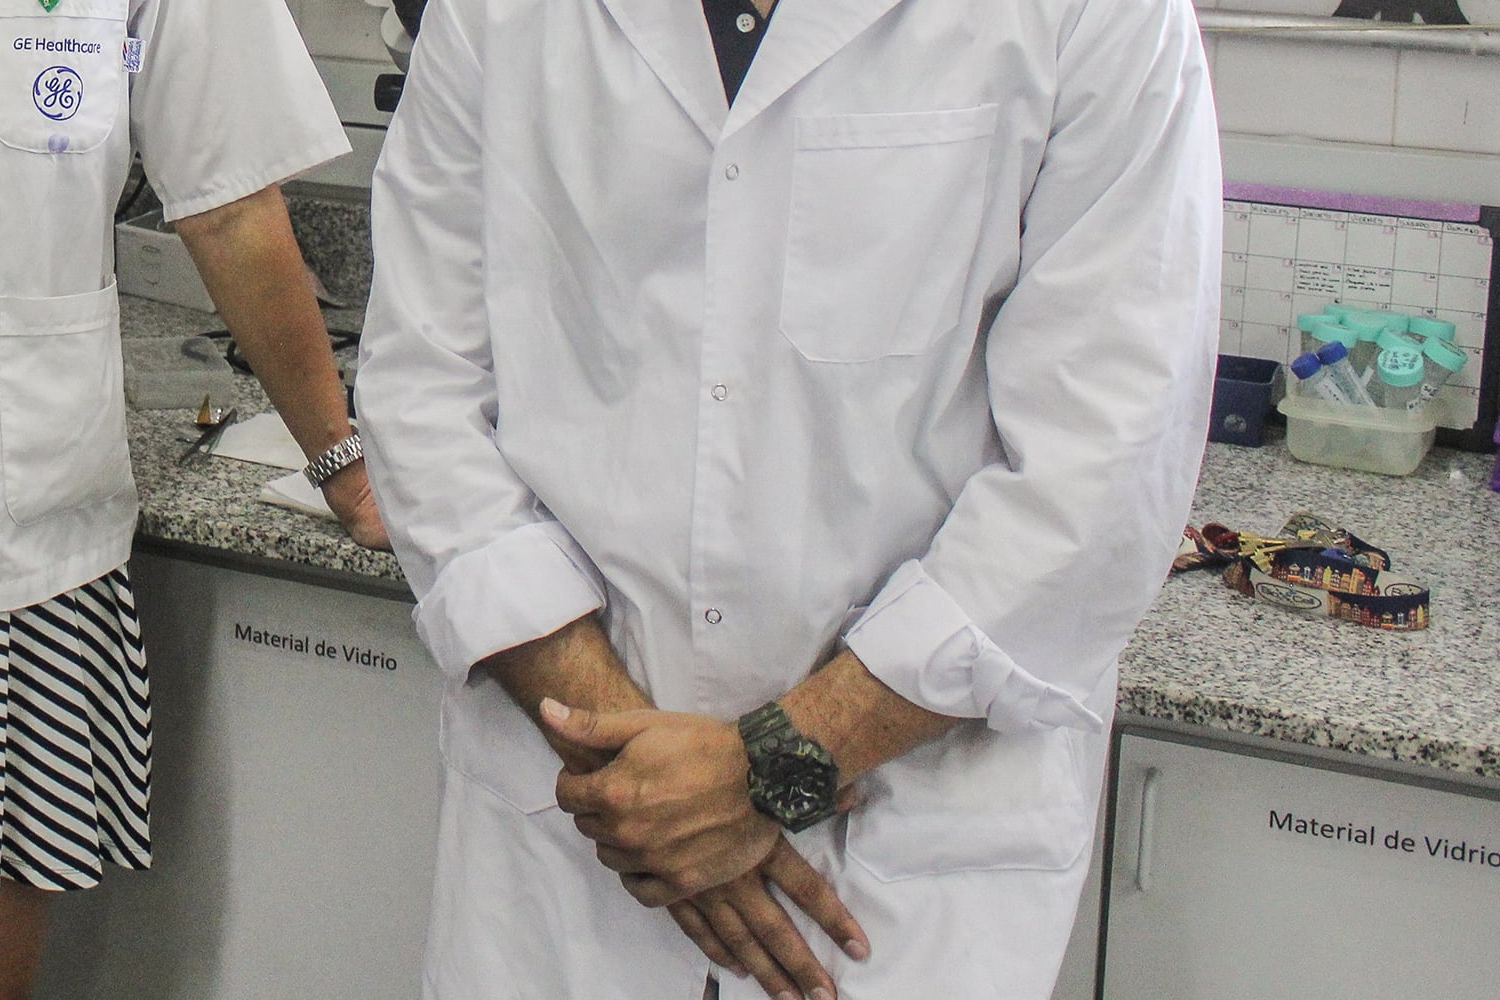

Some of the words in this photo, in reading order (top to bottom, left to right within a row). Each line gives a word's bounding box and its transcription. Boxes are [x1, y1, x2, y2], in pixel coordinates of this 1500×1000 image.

[13, 37, 33, 51] GE
[35, 37, 101, 54] Healthcare
[234, 622, 309, 657] Material
[314, 638, 337, 661] de
[342, 646, 398, 672] Vidrio
[1269, 809, 1375, 847] Material
[1383, 829, 1416, 853] de
[1423, 835, 1500, 868] Vidrio
